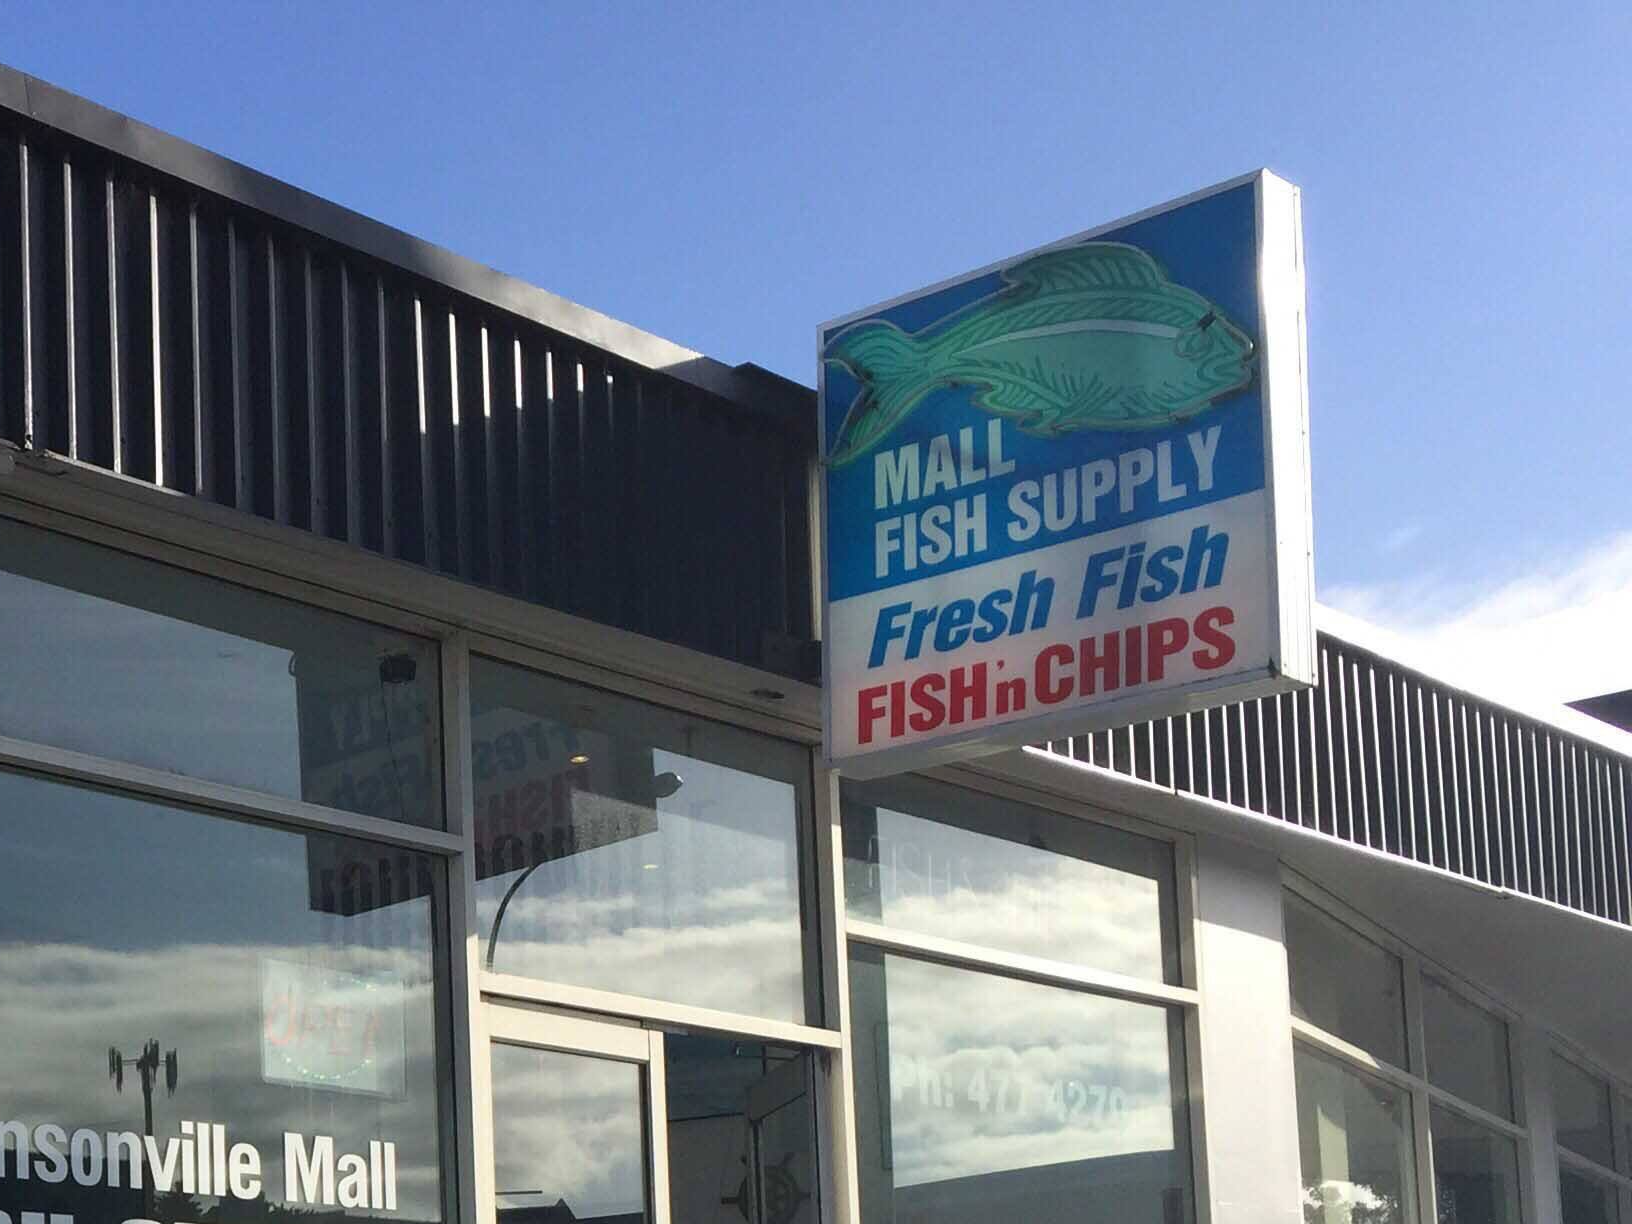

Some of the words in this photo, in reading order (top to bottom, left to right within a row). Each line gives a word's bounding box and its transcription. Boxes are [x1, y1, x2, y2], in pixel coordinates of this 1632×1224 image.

[874, 417, 1016, 511] MALL
[874, 494, 989, 580] FISH
[1007, 425, 1222, 543] SUPPLY
[868, 570, 1056, 669] Fresh
[1075, 524, 1230, 620] Fish
[285, 1131, 397, 1211] Mall
